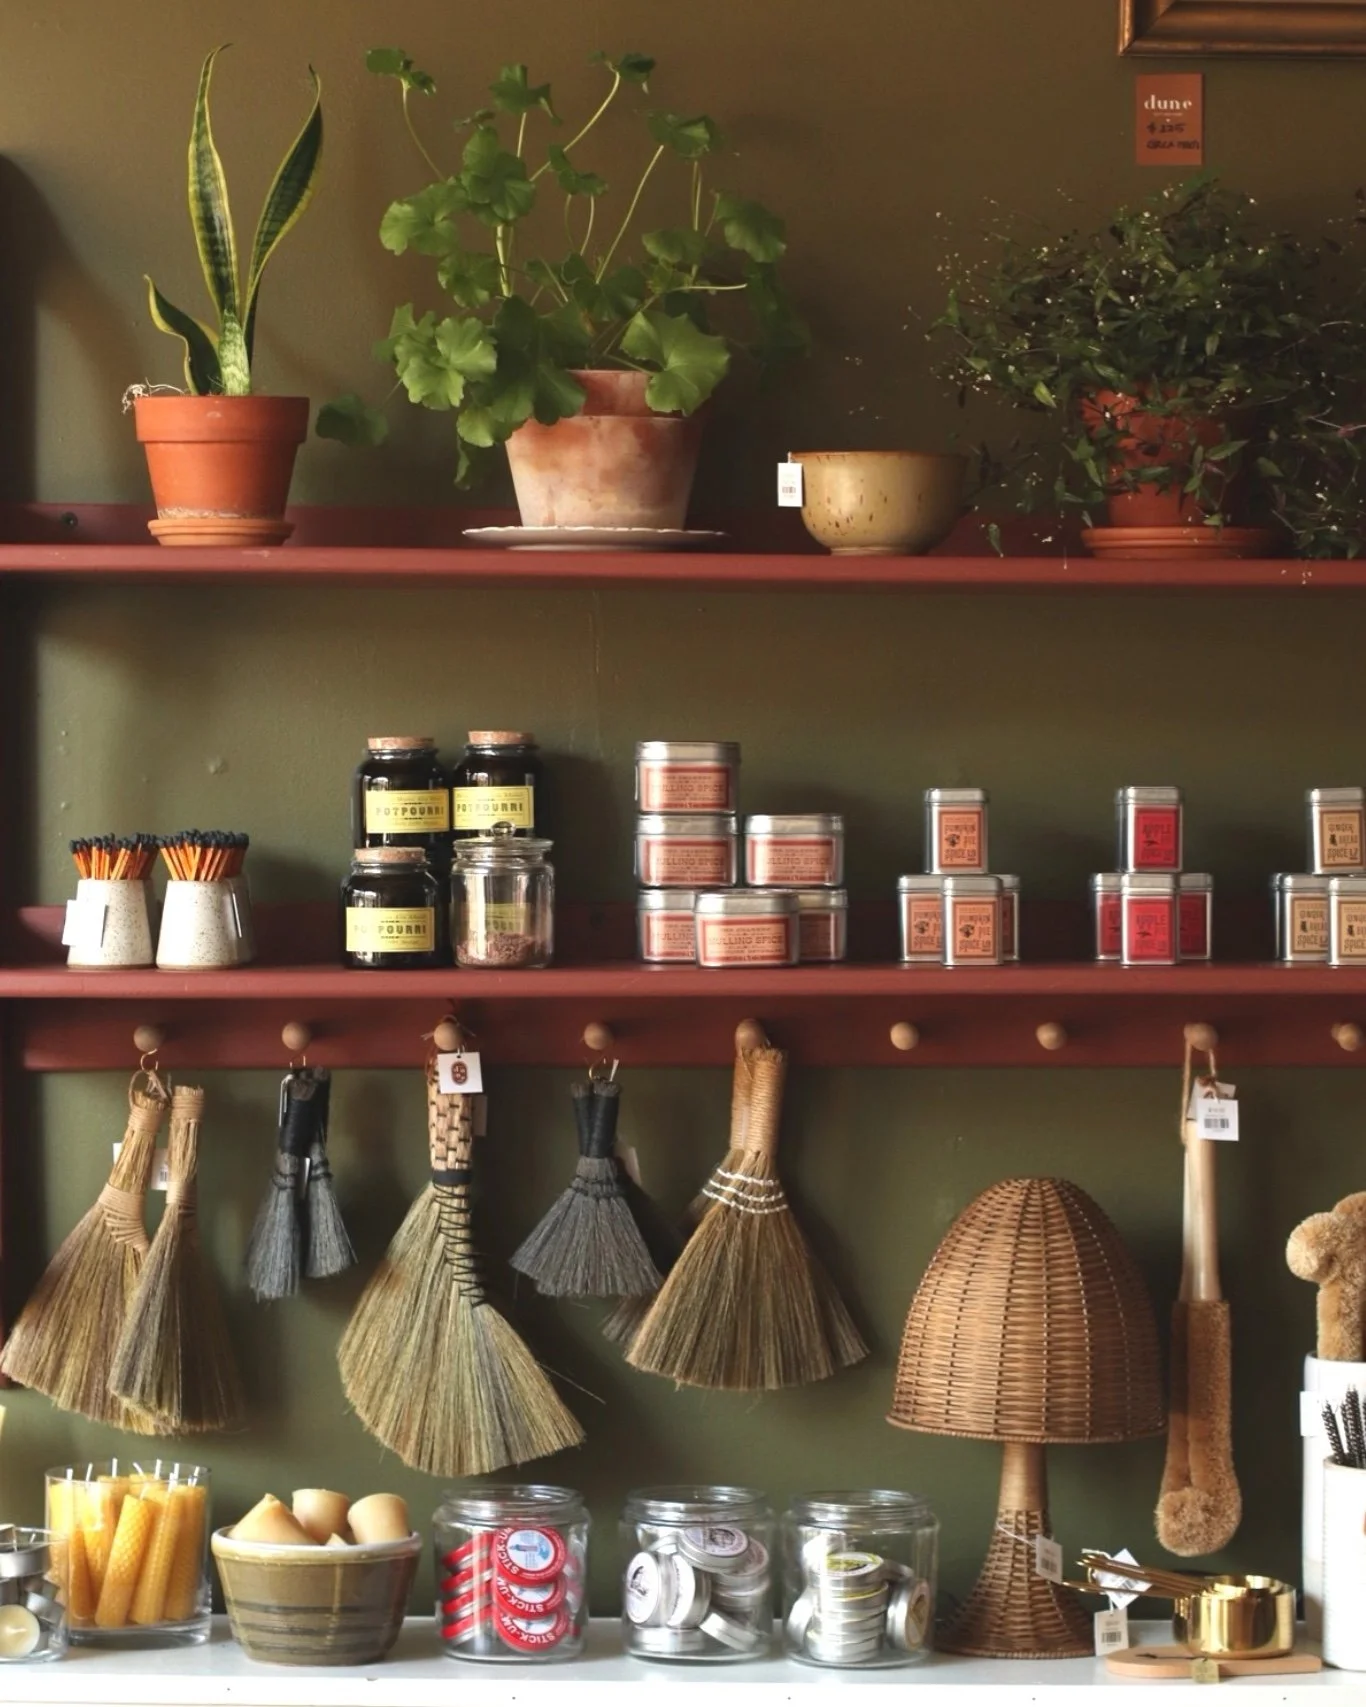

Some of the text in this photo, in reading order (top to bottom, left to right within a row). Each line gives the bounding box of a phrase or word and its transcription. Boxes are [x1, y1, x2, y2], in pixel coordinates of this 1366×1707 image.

[1144, 94, 1193, 110] dune
[376, 806, 444, 816] POTPOURRI
[456, 802, 523, 812] POTPOURRI
[355, 924, 427, 935] POPOURRI
[496, 1576, 545, 1614] STICK-UM
[500, 1615, 557, 1645] STICK-UM
